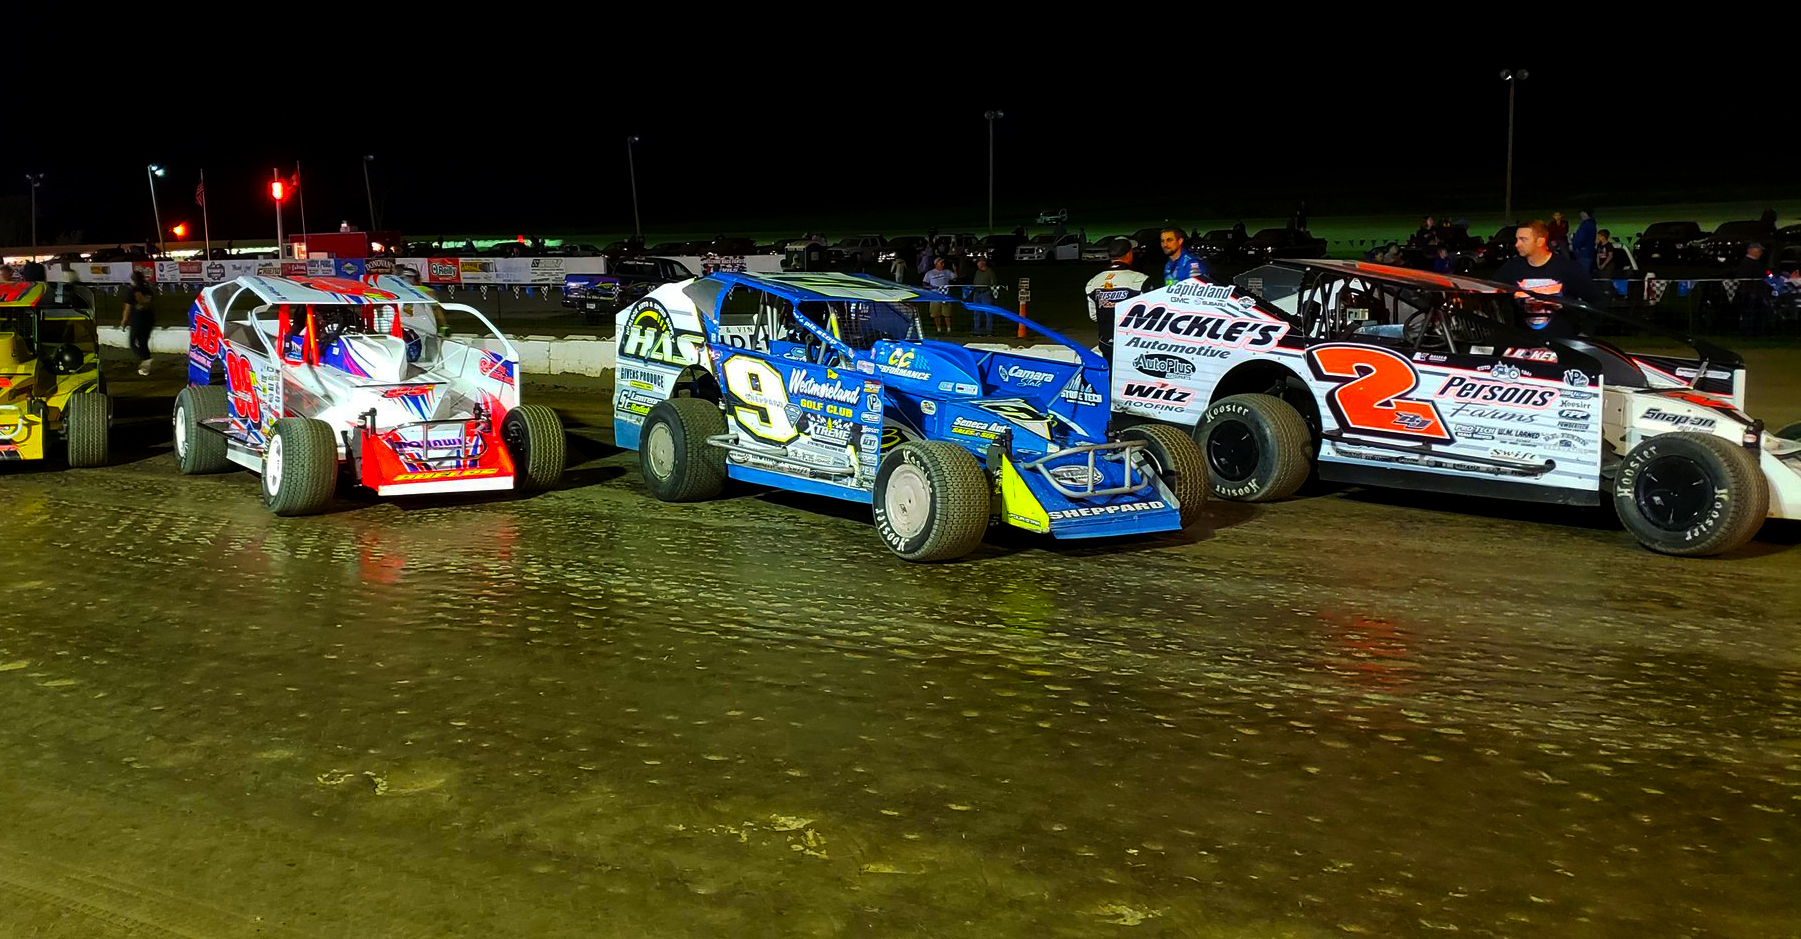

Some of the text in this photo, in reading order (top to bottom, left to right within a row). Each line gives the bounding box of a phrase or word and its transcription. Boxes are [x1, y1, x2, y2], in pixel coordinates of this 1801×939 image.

[1166, 282, 1233, 300] Capitaland
[1171, 296, 1190, 304] GMC
[1119, 303, 1282, 346] MICKLE'S
[1125, 336, 1232, 359] Automotive
[1008, 365, 1055, 383] Camara
[1135, 353, 1192, 376] AutoPlus
[640, 370, 665, 389] PRODUCE
[789, 367, 861, 405] Westmoreland
[723, 355, 800, 443] 9
[1124, 383, 1192, 403] Witz
[1307, 343, 1450, 443] 2
[1438, 376, 1556, 407] Persons
[800, 398, 853, 418] GOLF CLUB
[1124, 400, 1186, 413] ROOFING
[1205, 402, 1249, 424] Hoosier
[953, 416, 1007, 433] Seneca Aut
[1616, 445, 1658, 500] Hoosier
[1215, 478, 1261, 497] Hoosier
[1048, 501, 1165, 519] SHEPPARD
[1685, 486, 1730, 541] Hoosier
[875, 508, 911, 552] Hoosier
